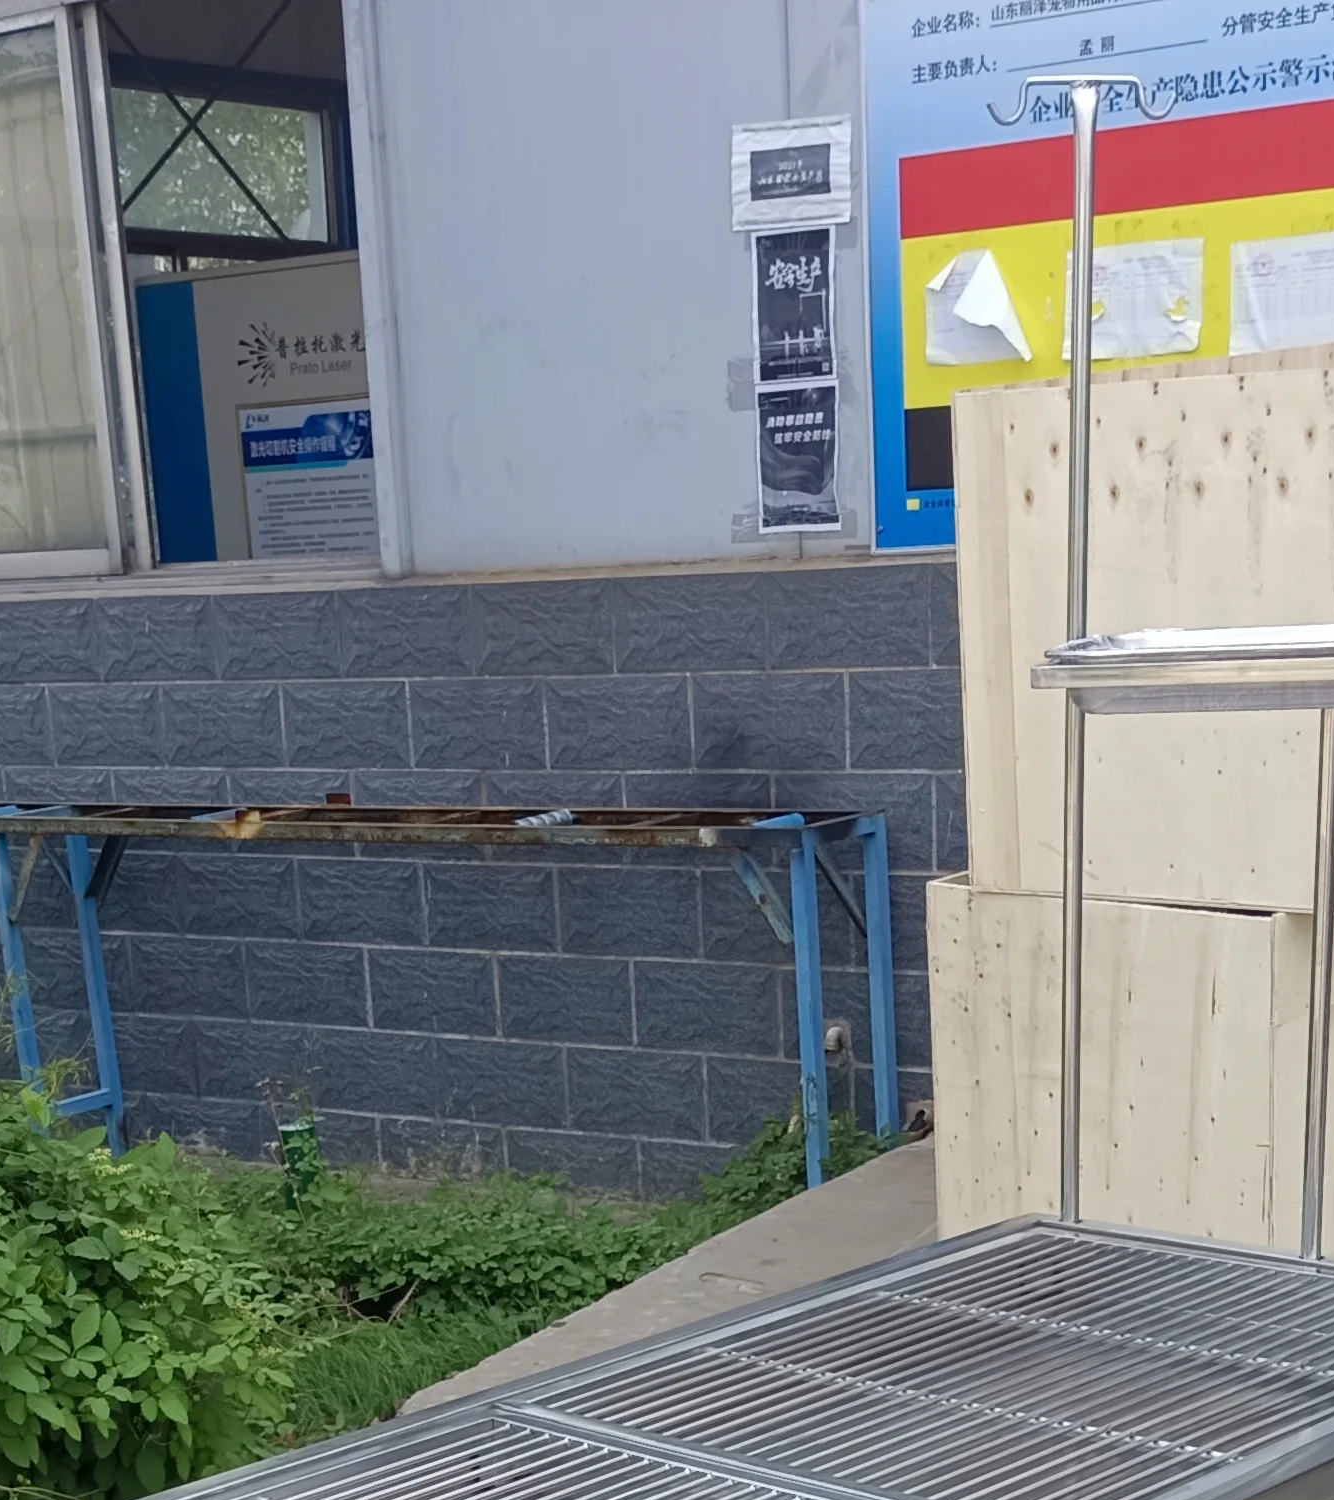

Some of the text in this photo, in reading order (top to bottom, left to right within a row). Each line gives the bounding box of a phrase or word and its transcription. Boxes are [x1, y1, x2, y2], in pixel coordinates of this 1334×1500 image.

[991, 0, 1124, 21] 山东丽泽宠物用
[911, 55, 998, 84] 主要负责人：
[765, 256, 823, 293] 安全生产
[289, 359, 353, 376] Prato Laser
